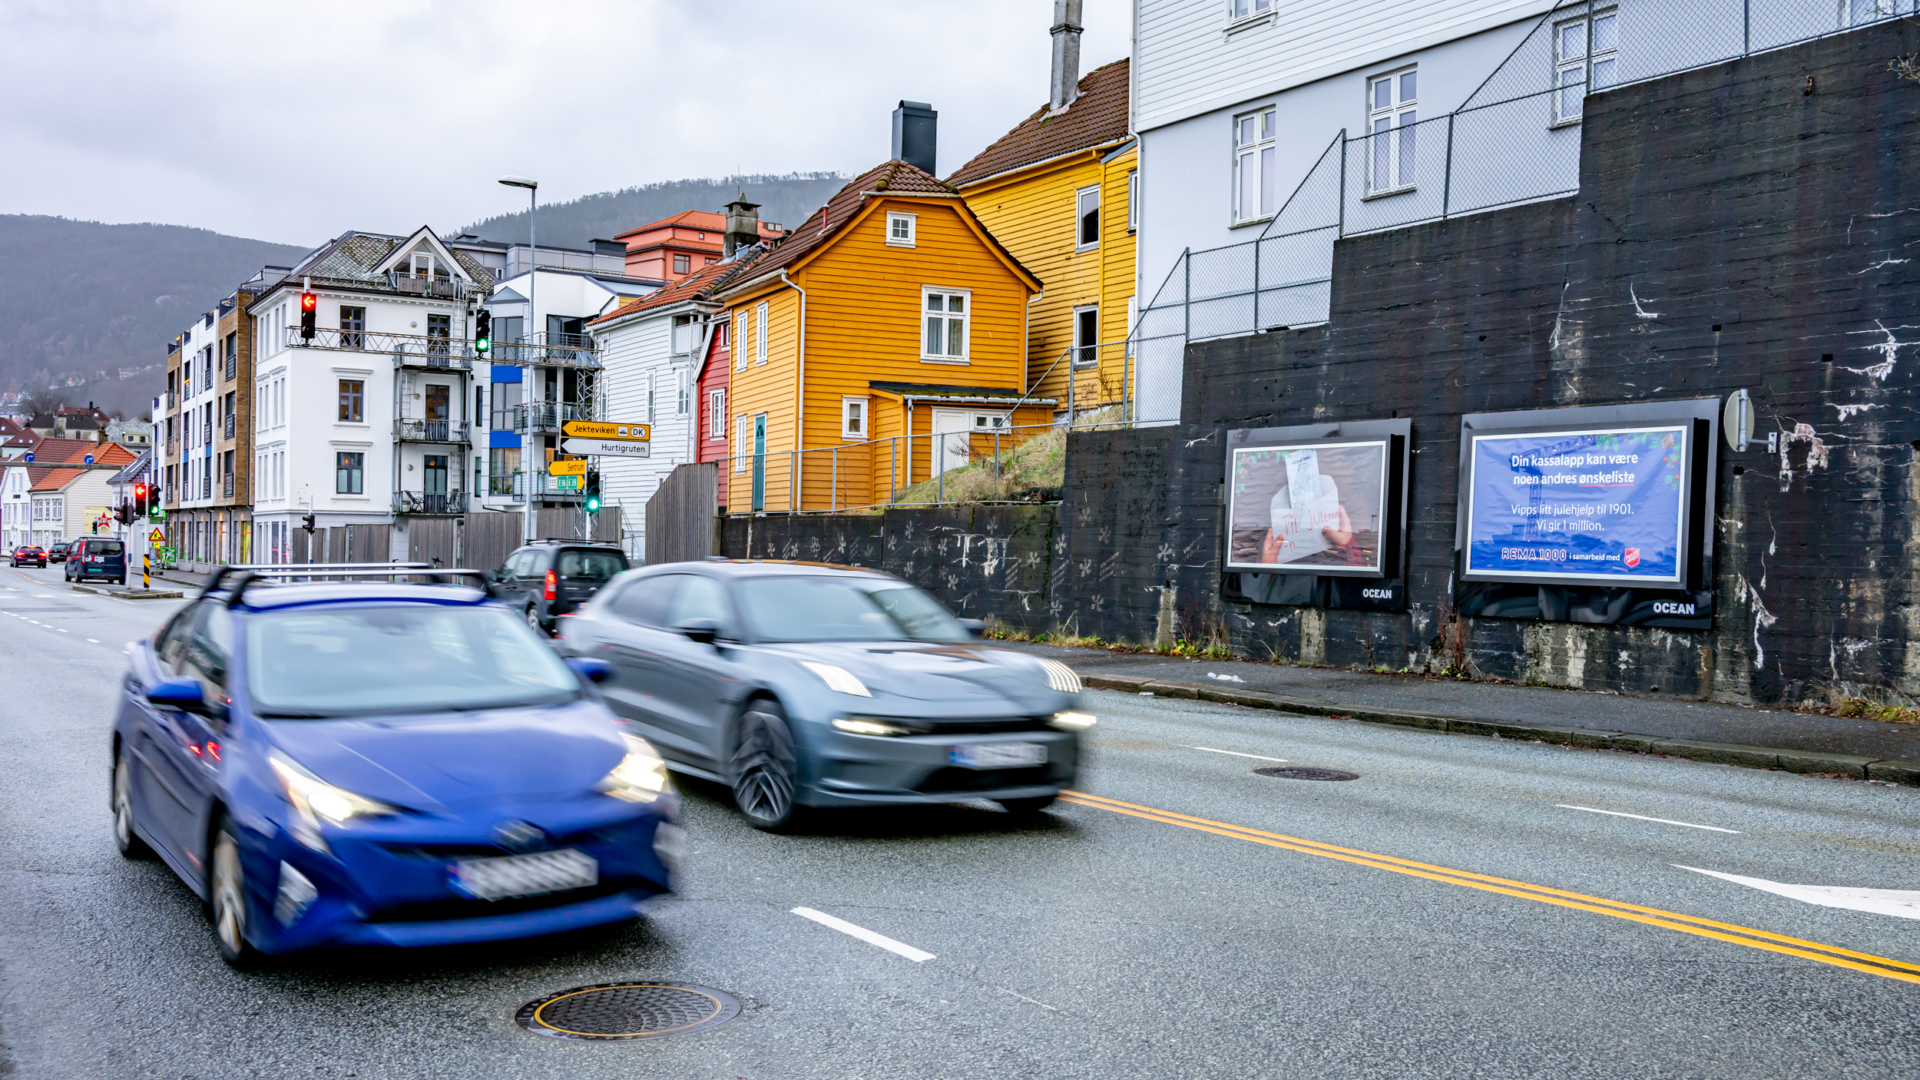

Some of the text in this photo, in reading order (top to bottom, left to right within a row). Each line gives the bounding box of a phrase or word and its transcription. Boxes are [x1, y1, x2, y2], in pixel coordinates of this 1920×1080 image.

[573, 425, 644, 436] Jekteviken DK
[601, 443, 646, 454] Hurtigruten
[567, 462, 584, 472] Sentrum
[1511, 453, 1638, 468] Din kassalapp kan være
[1513, 471, 1635, 485] noen andres ønskeliste
[1511, 503, 1635, 516] Vipps litt julehjelp til 1901.
[1282, 513, 1298, 536] Til
[1536, 519, 1546, 531] Vi
[1548, 520, 1561, 533] gir
[1569, 519, 1605, 531] million.
[1501, 548, 1567, 561] REMA 1000
[1572, 552, 1605, 561] samarbeid
[1606, 553, 1620, 561] med
[1362, 588, 1392, 599] OCEAN
[1653, 602, 1695, 615] OCEAN
